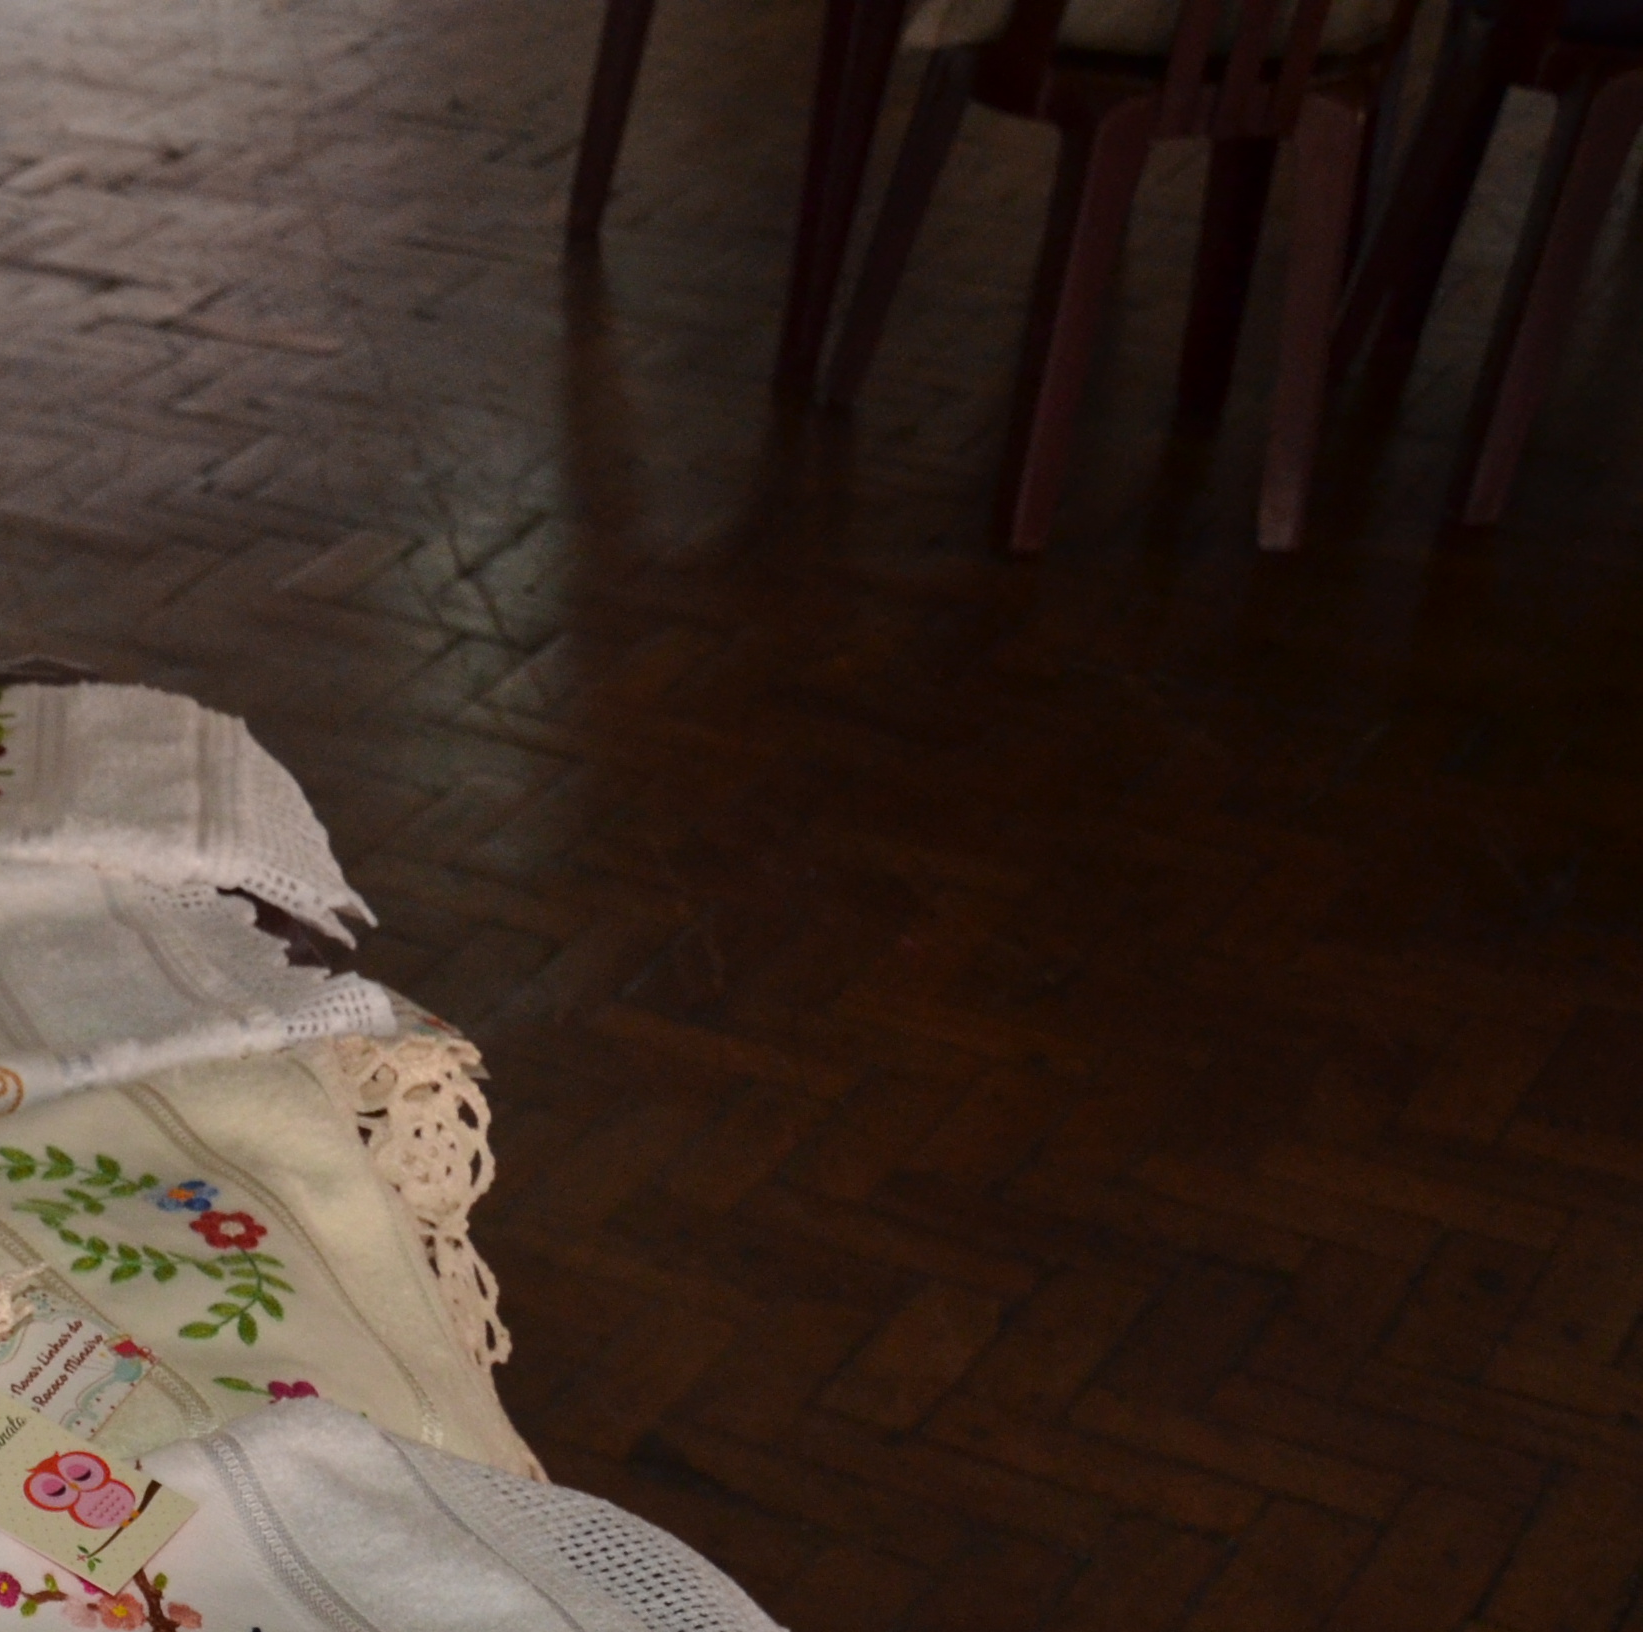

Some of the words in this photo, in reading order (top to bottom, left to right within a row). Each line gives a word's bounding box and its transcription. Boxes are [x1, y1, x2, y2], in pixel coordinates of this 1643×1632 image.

[10, 1365, 43, 1396] Novas
[37, 1333, 72, 1371] Linhas
[67, 1320, 84, 1334] do
[32, 1374, 69, 1407] Rococo
[64, 1334, 104, 1375] Mineiro
